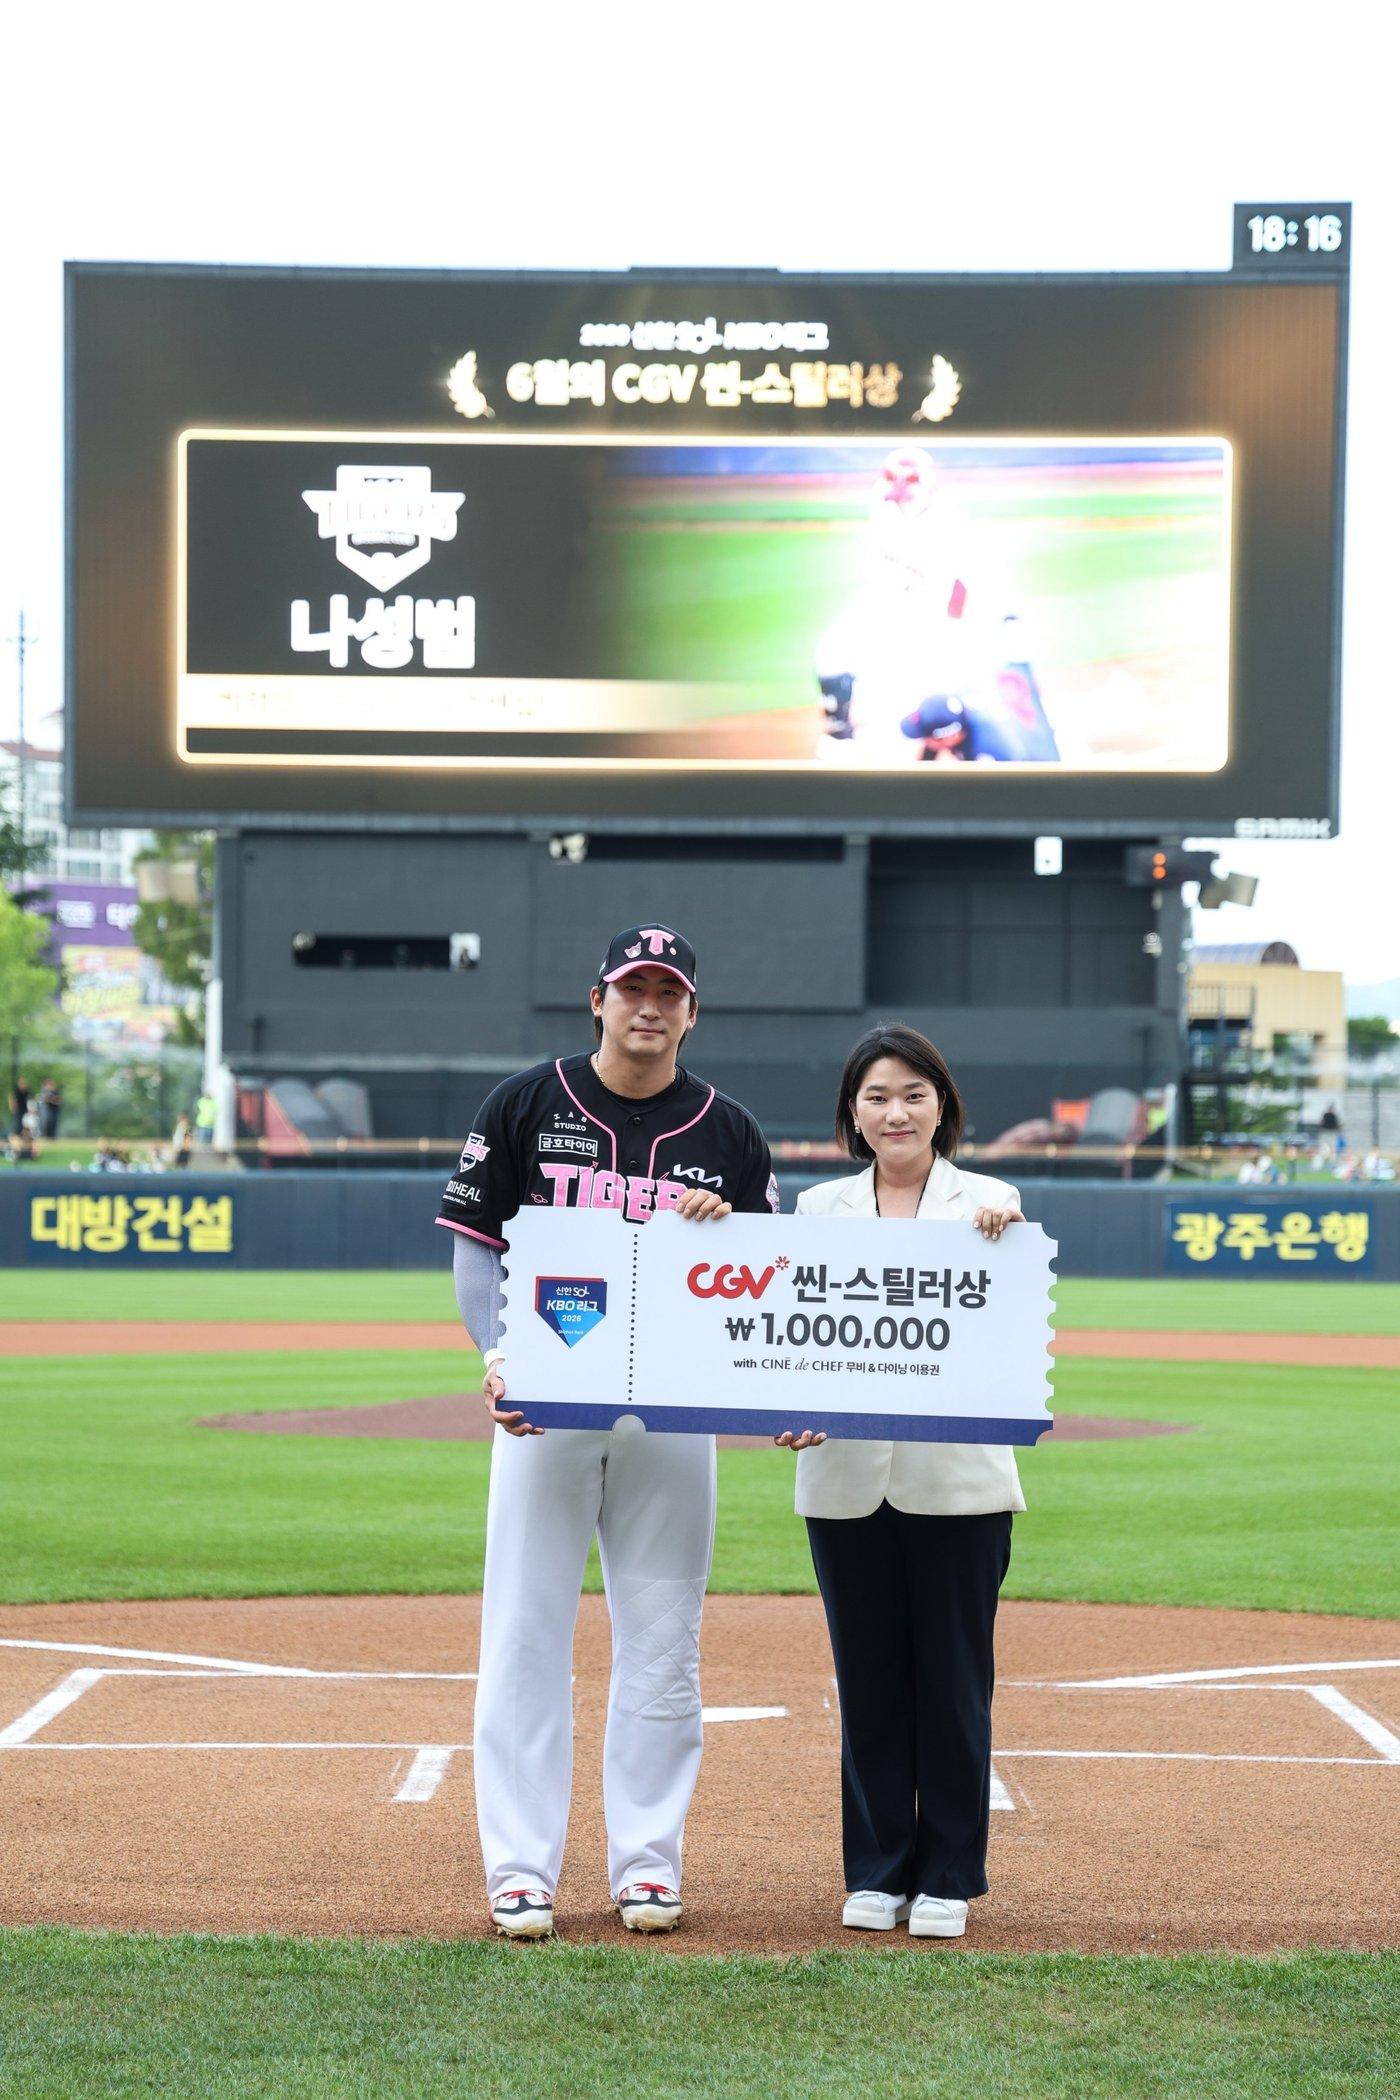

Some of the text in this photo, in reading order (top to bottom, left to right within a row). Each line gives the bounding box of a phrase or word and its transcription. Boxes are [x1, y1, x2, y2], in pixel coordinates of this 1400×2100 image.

[611, 362, 699, 404] CGV
[639, 930, 676, 956] T
[554, 1122, 587, 1132] STUDIO
[541, 1137, 596, 1154] 금호타이어
[539, 1163, 706, 1223] TIGER
[31, 1194, 233, 1253] 대방건설
[1172, 1211, 1369, 1262] 광주은행
[687, 1262, 992, 1309] CGV 씬-스틸러상
[546, 1300, 598, 1312] KBO 리그
[733, 1358, 757, 1369] with
[794, 1357, 810, 1371] de
[812, 1360, 844, 1372] CHEF
[846, 1361, 866, 1374] 무비
[868, 1363, 876, 1373] &
[877, 1363, 907, 1375] 다이닝
[909, 1364, 940, 1377] 이용권
